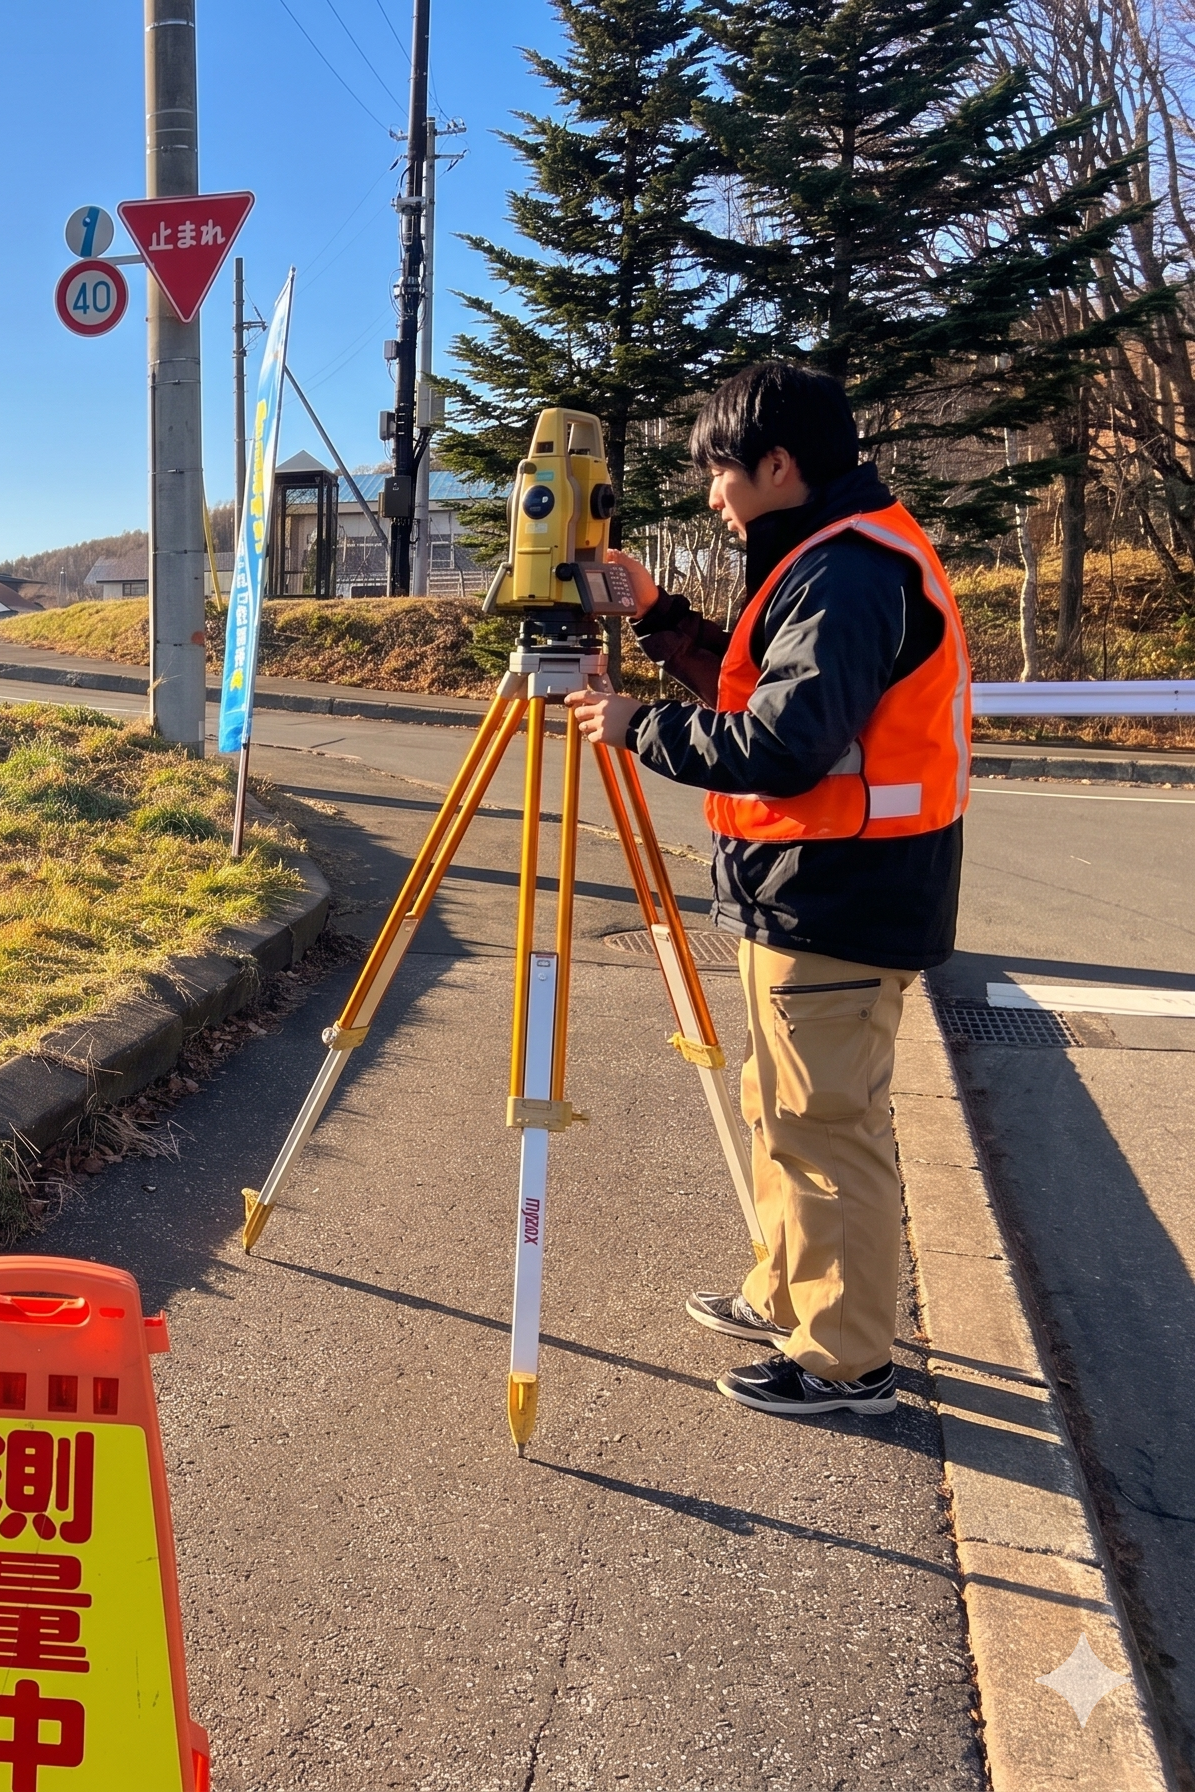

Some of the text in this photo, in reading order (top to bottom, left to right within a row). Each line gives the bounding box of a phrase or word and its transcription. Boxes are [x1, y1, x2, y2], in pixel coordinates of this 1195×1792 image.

[148, 219, 226, 251] 止まれ
[72, 280, 111, 315] 40
